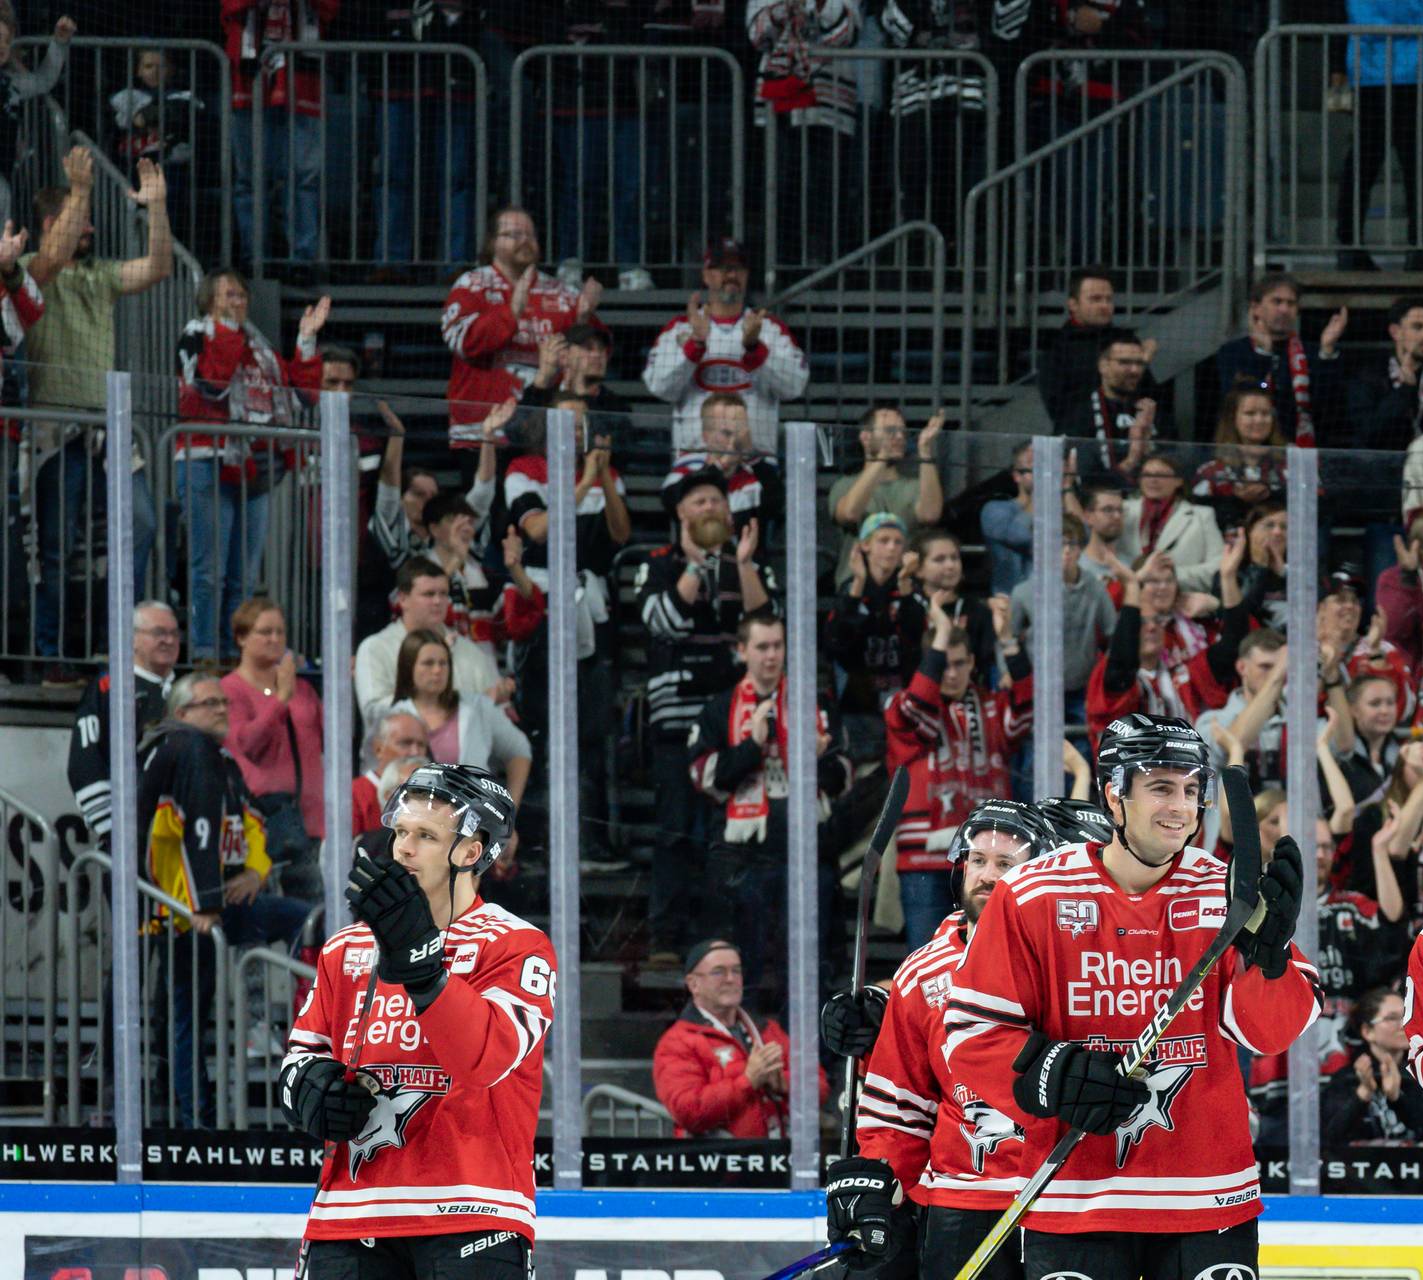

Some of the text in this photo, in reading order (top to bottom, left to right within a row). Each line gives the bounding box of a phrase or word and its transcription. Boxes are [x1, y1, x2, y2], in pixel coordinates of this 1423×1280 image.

[77, 715, 100, 748] 10
[195, 818, 210, 849] 9
[1019, 850, 1077, 875] HIT
[1058, 899, 1098, 926] 50
[1081, 951, 1182, 986] Rhein
[399, 1068, 449, 1092] HAIE
[0, 1144, 115, 1163] HLWERK
[147, 1145, 323, 1167] STAHLWERK
[589, 1154, 788, 1172] STAHLWERK
[827, 1177, 885, 1195] WOOD
[447, 1204, 499, 1215] BAUER
[460, 1230, 518, 1259] BAUER
